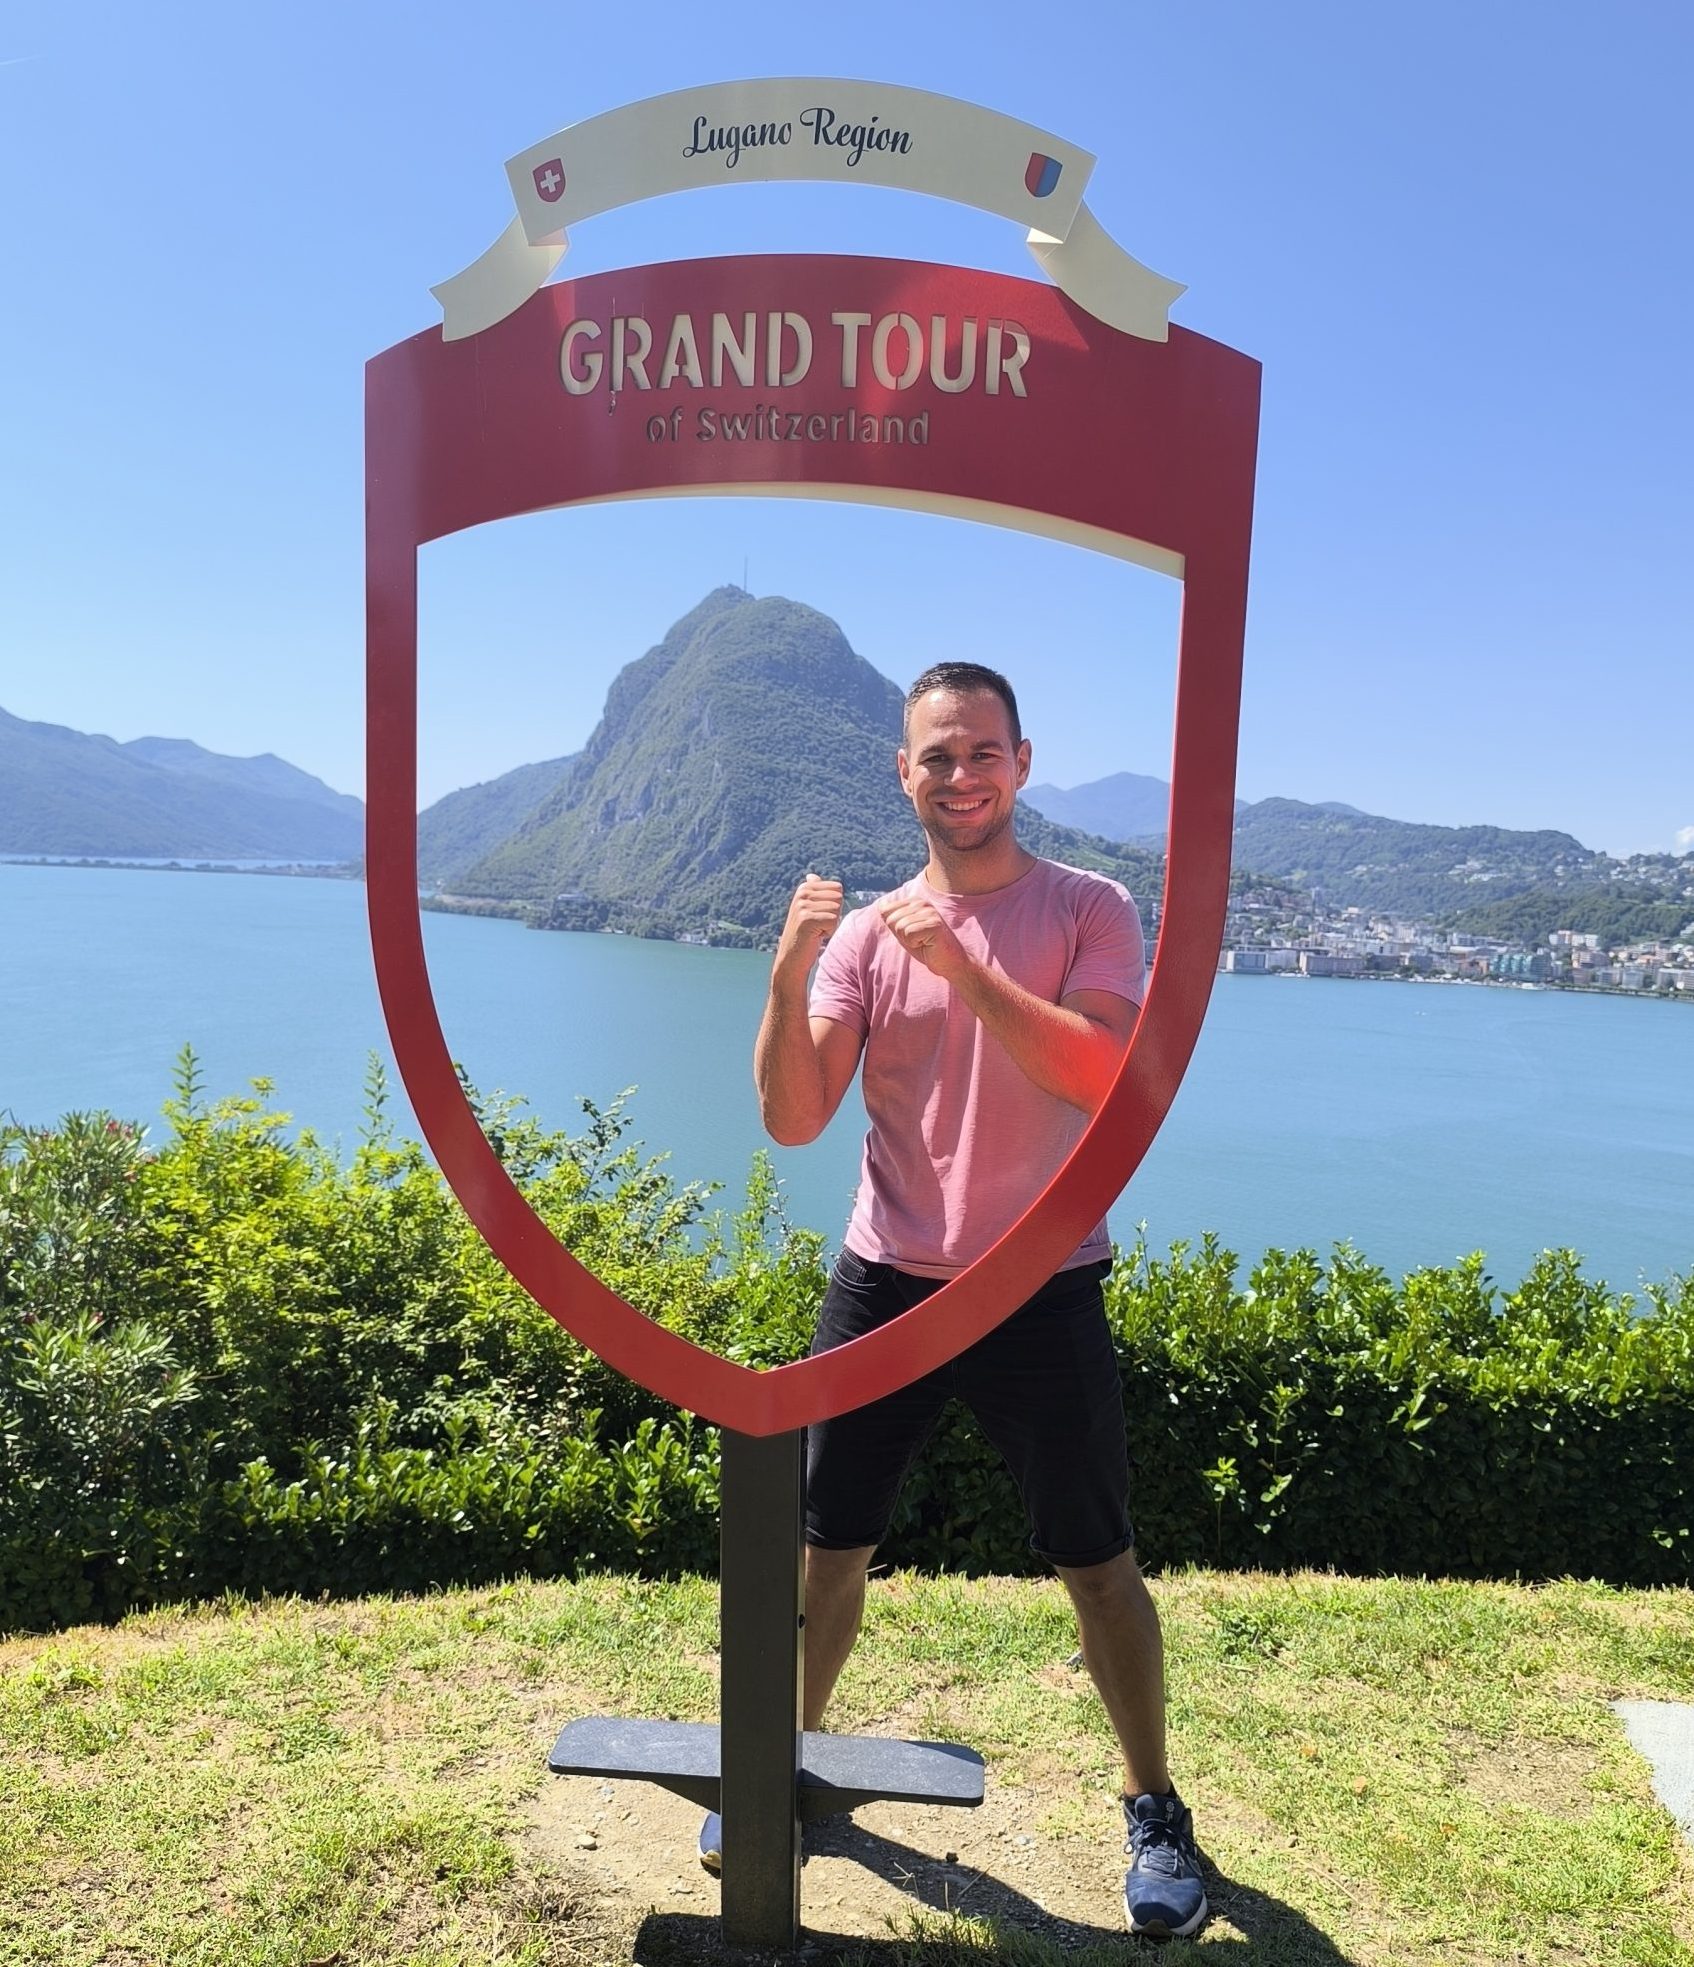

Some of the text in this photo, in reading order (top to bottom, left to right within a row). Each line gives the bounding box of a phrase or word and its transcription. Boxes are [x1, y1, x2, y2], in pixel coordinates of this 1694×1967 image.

[682, 107, 913, 168] Lugano Region
[560, 311, 1031, 398] GRAND TOUR
[646, 404, 929, 444] of Switzerland
